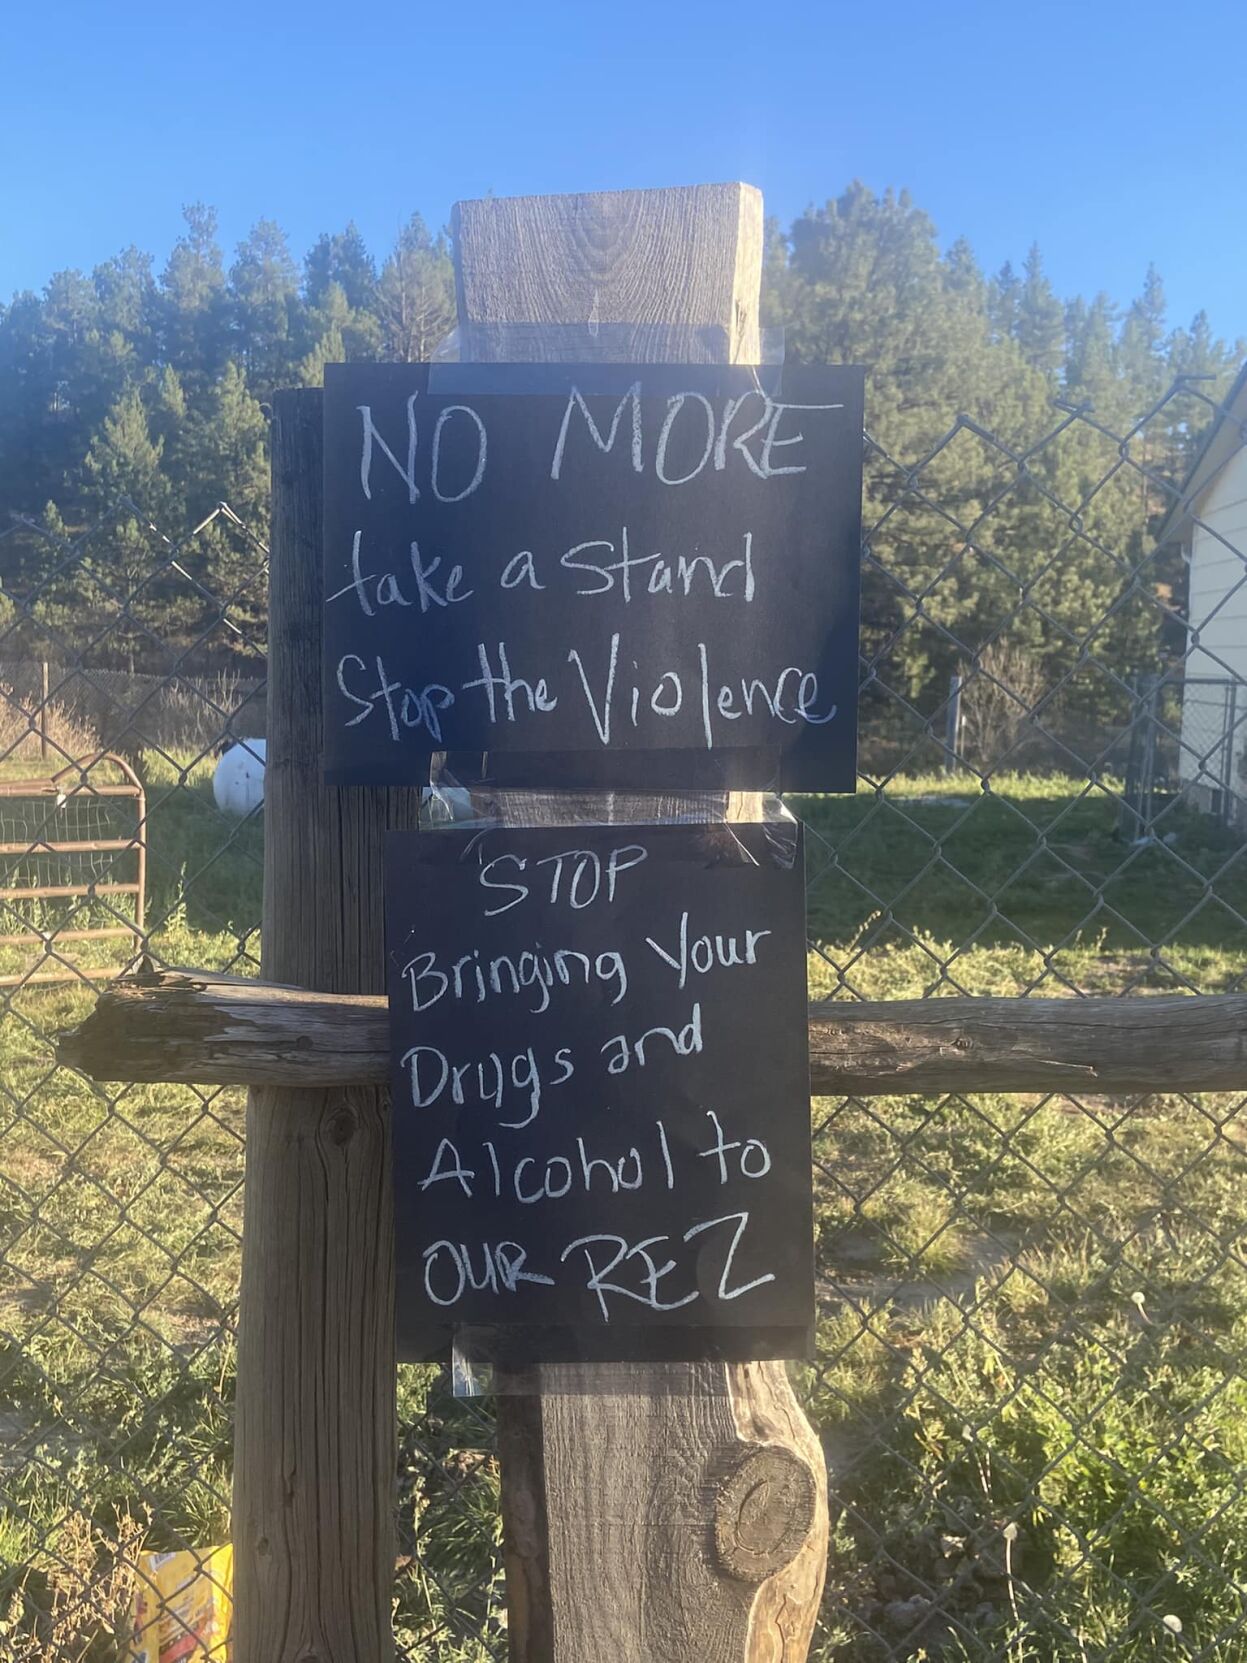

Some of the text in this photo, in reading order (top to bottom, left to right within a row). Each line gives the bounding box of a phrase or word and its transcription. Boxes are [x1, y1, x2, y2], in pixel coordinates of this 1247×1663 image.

[357, 381, 844, 504] NO MORE
[325, 530, 474, 616] take
[500, 551, 546, 590] a
[336, 633, 837, 750] Stop the Violence
[479, 845, 648, 916] STOP
[402, 943, 627, 1014] Bringing
[401, 1003, 703, 1128] Drugs and
[417, 1110, 771, 1203] Alcohol to
[422, 1211, 776, 1322] OUR REZ
